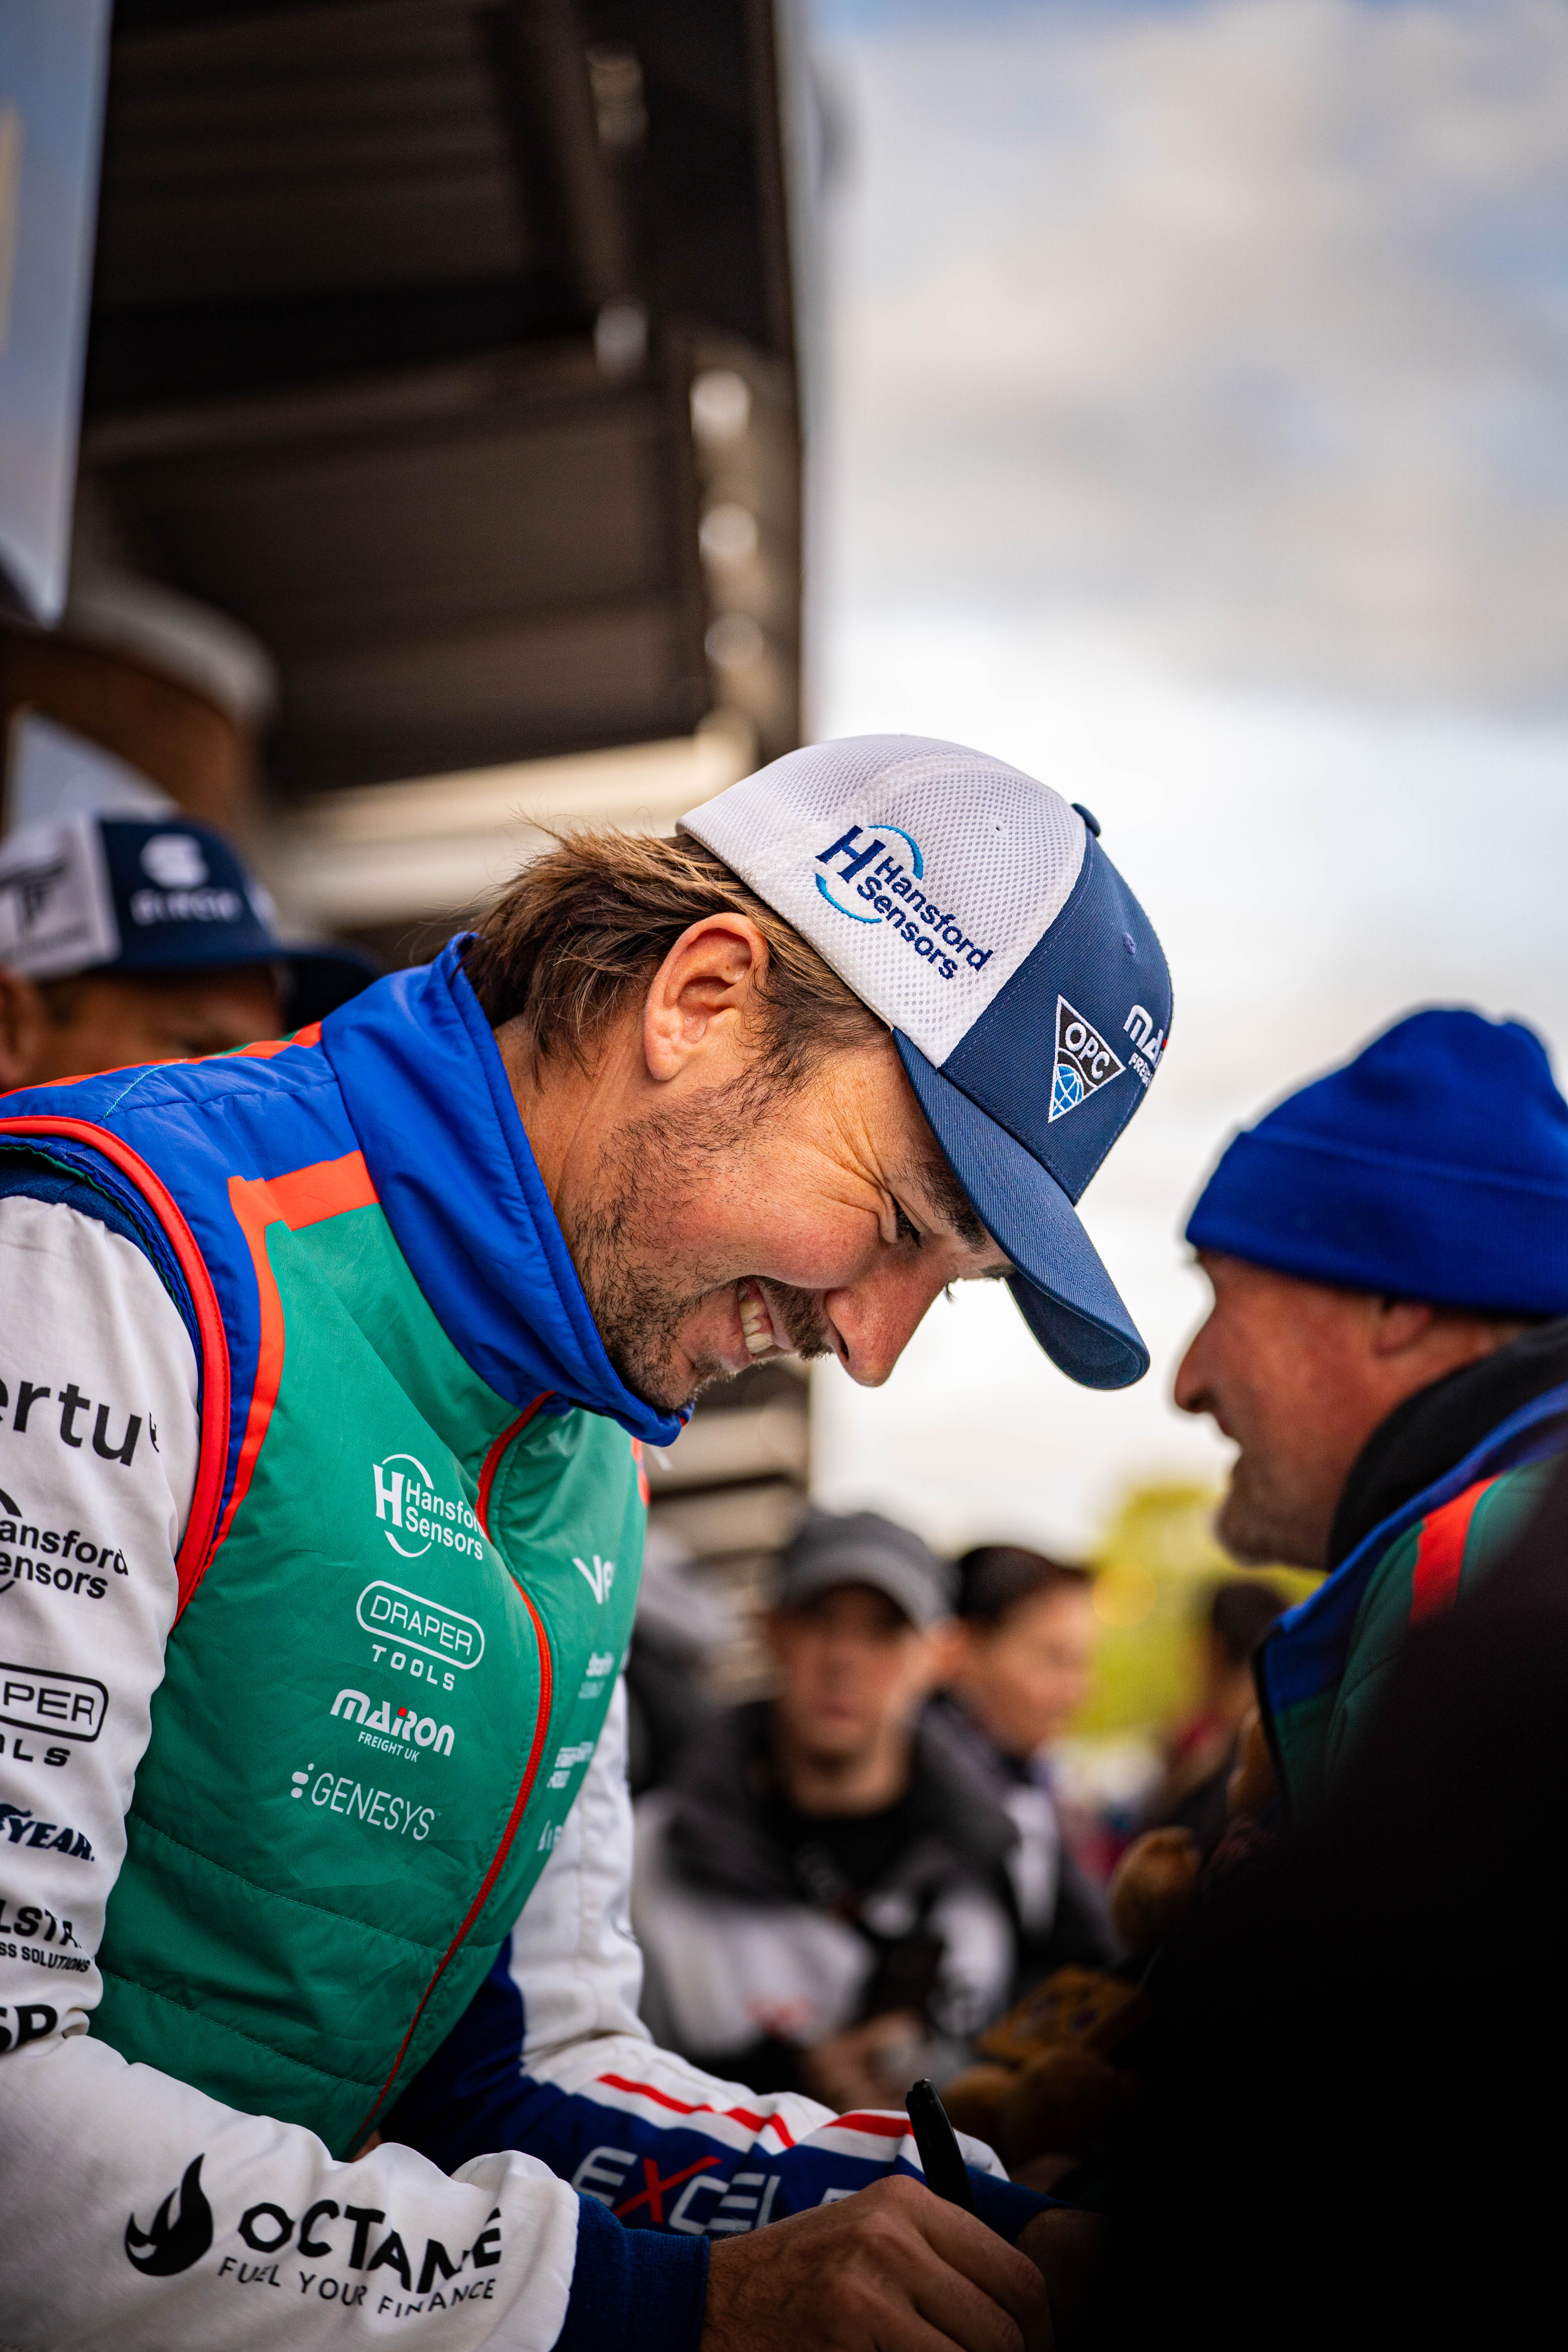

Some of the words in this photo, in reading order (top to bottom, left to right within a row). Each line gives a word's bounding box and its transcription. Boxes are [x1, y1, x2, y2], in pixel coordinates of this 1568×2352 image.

[857, 877, 958, 980] Sensors
[874, 856, 994, 971] Hansford
[1065, 1022, 1111, 1080] OPC
[405, 1506, 483, 1561] Sensors
[370, 1594, 473, 1656] DRAPER
[372, 1644, 456, 1691] TOOLS
[358, 1731, 405, 1759] FREIGHT
[404, 1746, 421, 1763] UK
[312, 1772, 435, 1841] GENESYS
[22, 1945, 91, 1973] SOLUTIONS
[238, 2200, 502, 2294] OCTANE
[218, 2257, 281, 2287] FUEL
[298, 2271, 368, 2306] YOUR
[377, 2278, 496, 2318] FINANCE
